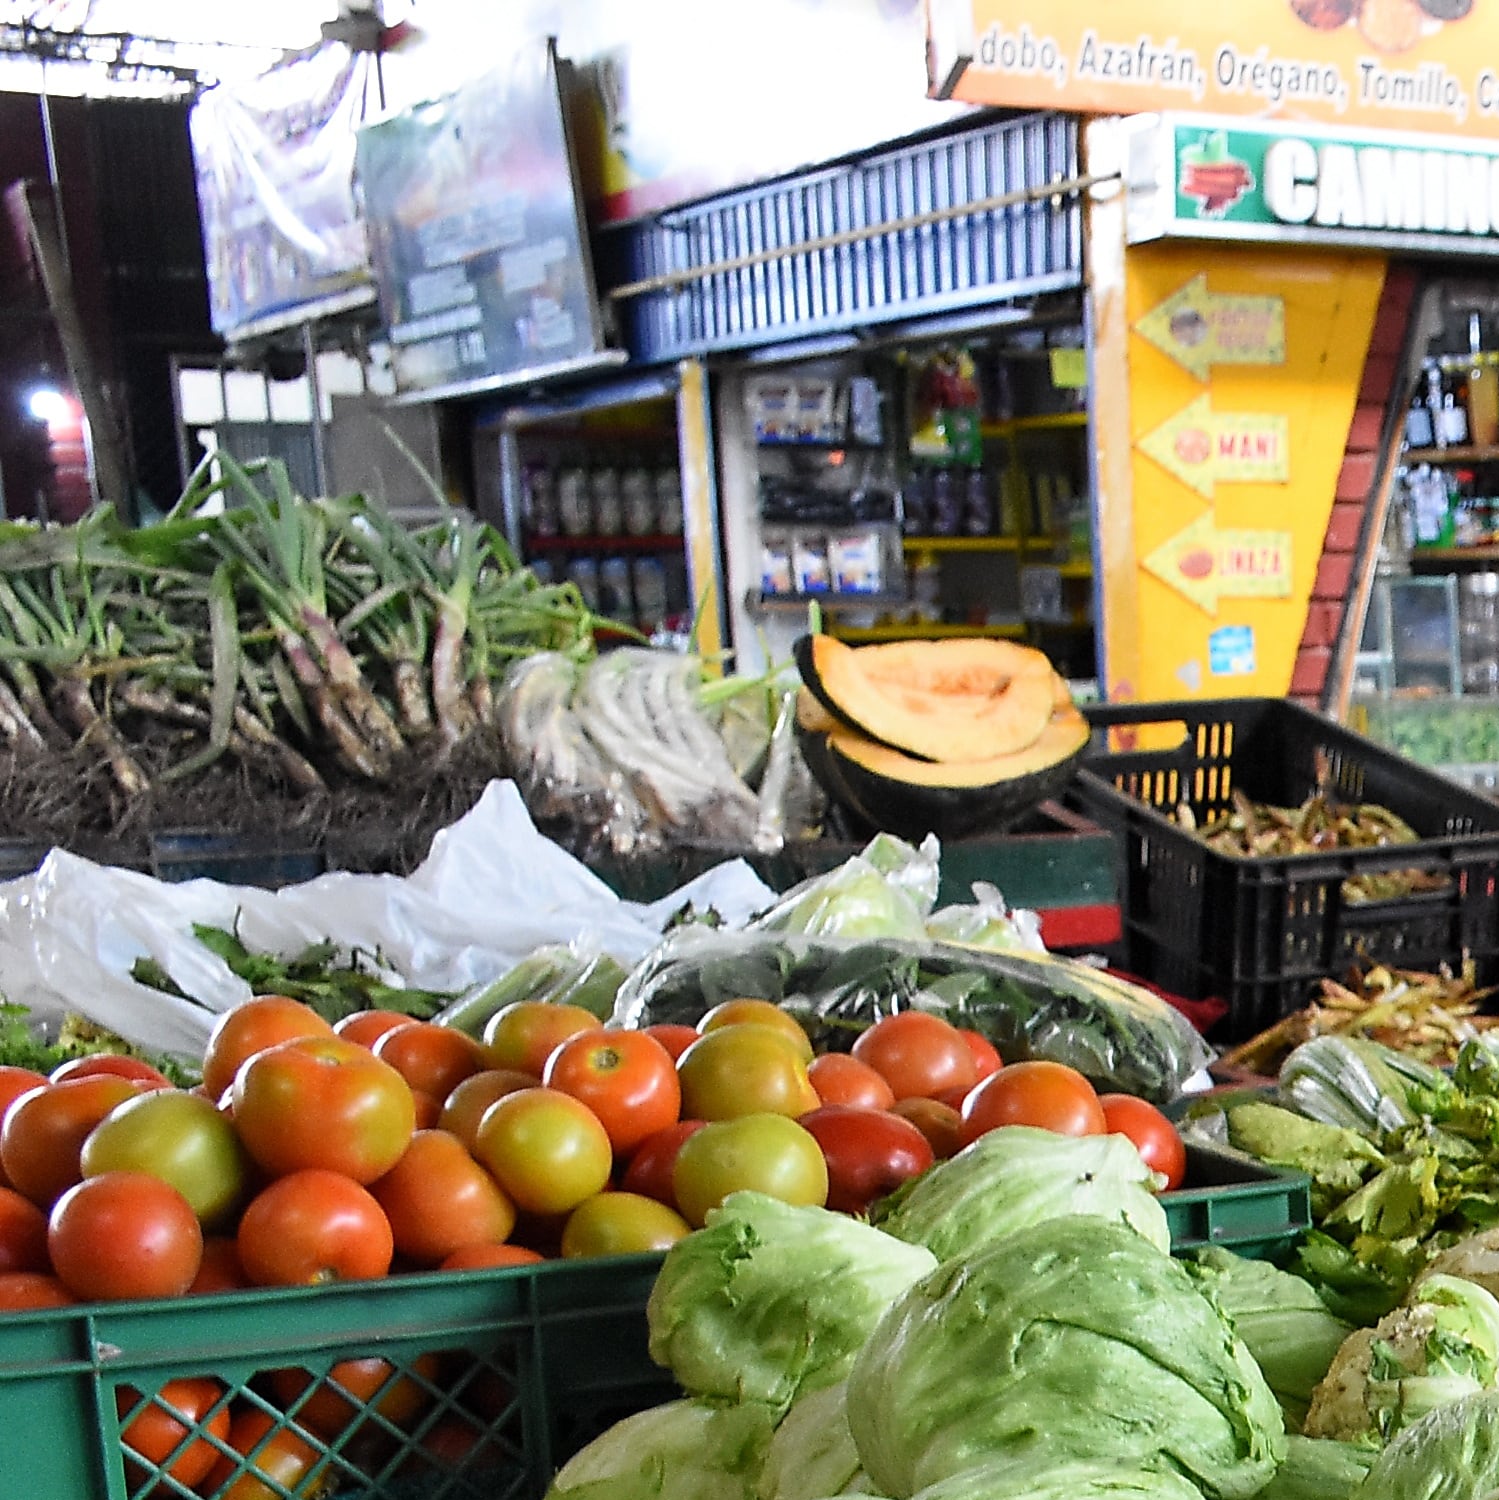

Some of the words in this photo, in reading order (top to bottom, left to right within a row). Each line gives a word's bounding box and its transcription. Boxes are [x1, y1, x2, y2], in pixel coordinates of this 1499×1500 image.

[976, 28, 1064, 82] dobo,
[1080, 36, 1201, 92] Azafrán,
[1217, 48, 1347, 99] Orégano,
[1361, 63, 1466, 114] Tomillo,
